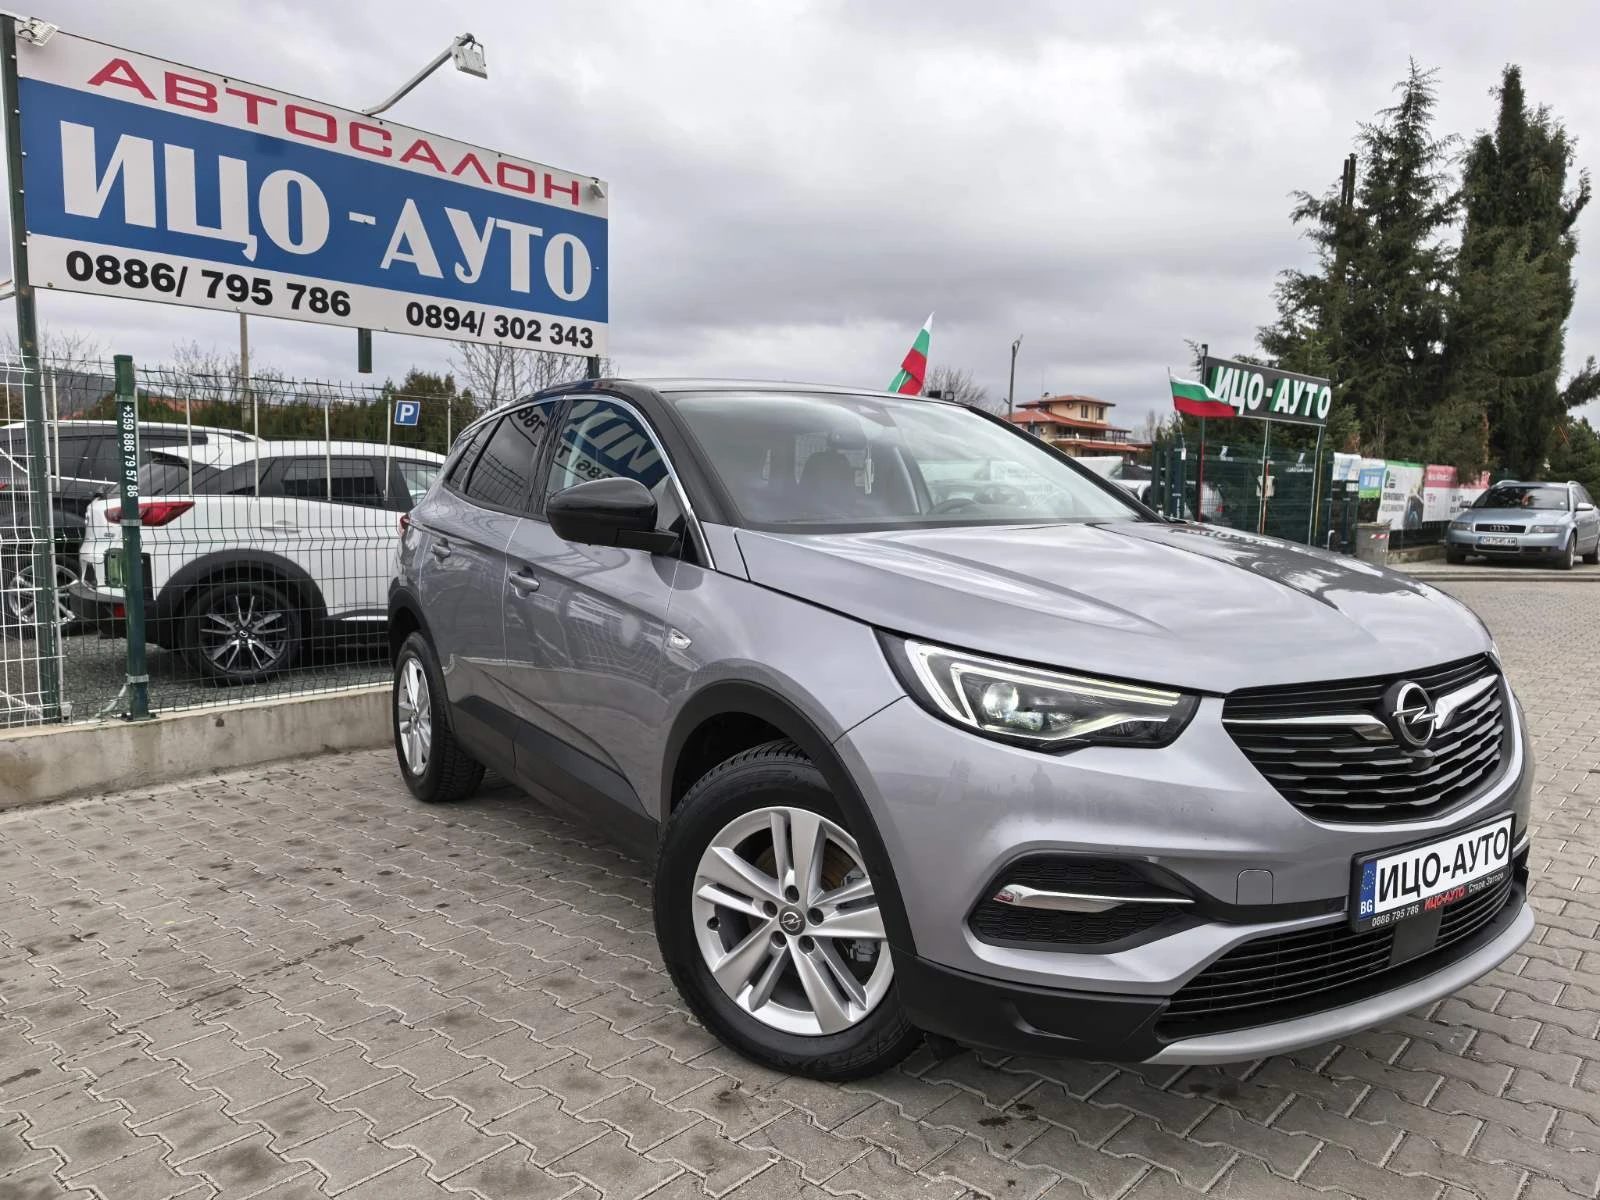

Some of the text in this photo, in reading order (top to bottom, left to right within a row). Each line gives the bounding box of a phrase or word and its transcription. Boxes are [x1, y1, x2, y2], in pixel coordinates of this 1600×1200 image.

[87, 57, 580, 206] АВТОСАЛОН
[66, 250, 594, 349] 0886/ 795 786 0894/ 302 343
[1213, 366, 1332, 420] ИЦО-АУТО
[122, 406, 138, 498] +359 886 79 57 86
[1371, 872, 1504, 928] 0886 795 786 ИЦО-АУТО Стара Загора
[1379, 827, 1509, 903] ИЦО-АУТО
[1360, 898, 1373, 915] BG
